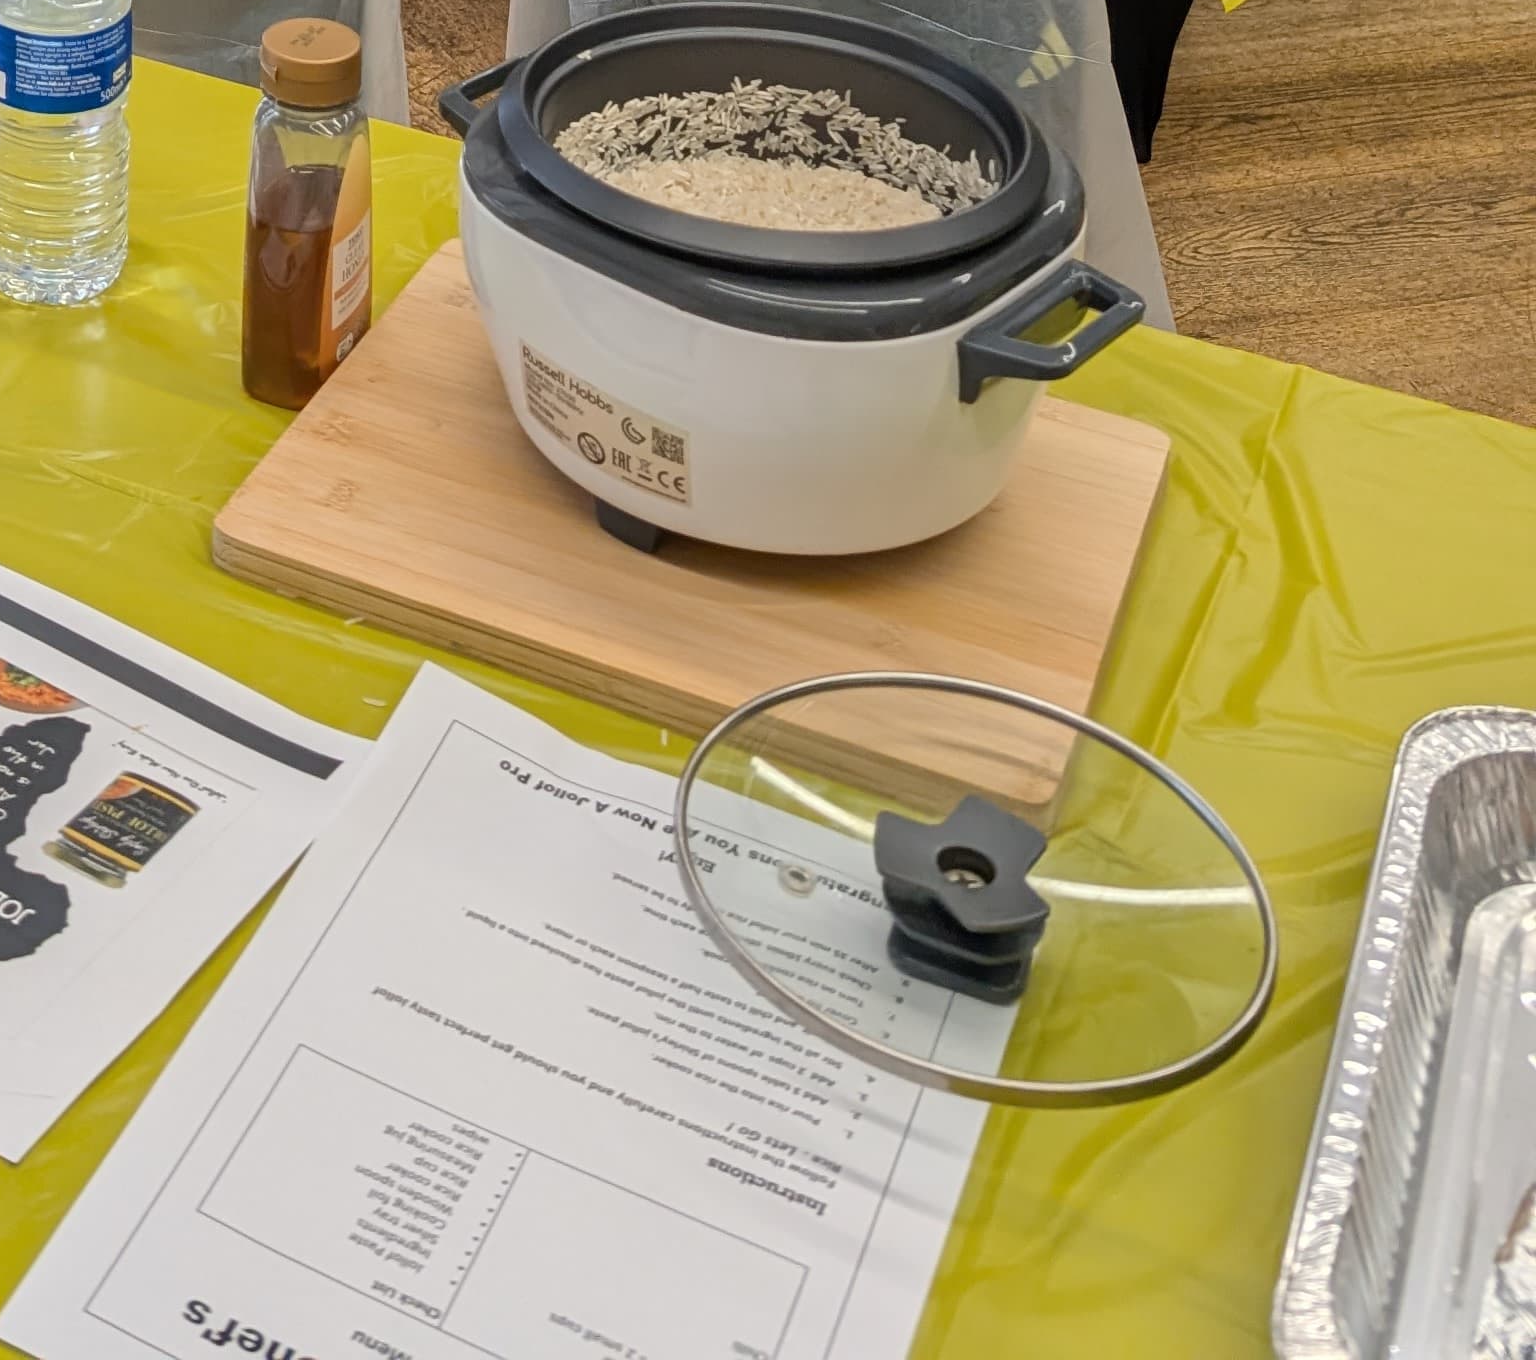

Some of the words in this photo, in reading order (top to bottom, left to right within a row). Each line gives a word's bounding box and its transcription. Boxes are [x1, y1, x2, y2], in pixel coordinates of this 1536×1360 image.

[522, 344, 566, 388] Russell
[568, 377, 614, 415] Hobbs
[2, 745, 28, 765] the
[26, 739, 56, 756] Jar
[499, 759, 532, 785] Pro
[532, 779, 591, 807] Jollof
[595, 800, 611, 814] A
[612, 807, 658, 831] Now
[703, 833, 740, 857] You
[706, 1157, 828, 1217] Instructions
[370, 1279, 399, 1300] List
[397, 1292, 444, 1320] Check
